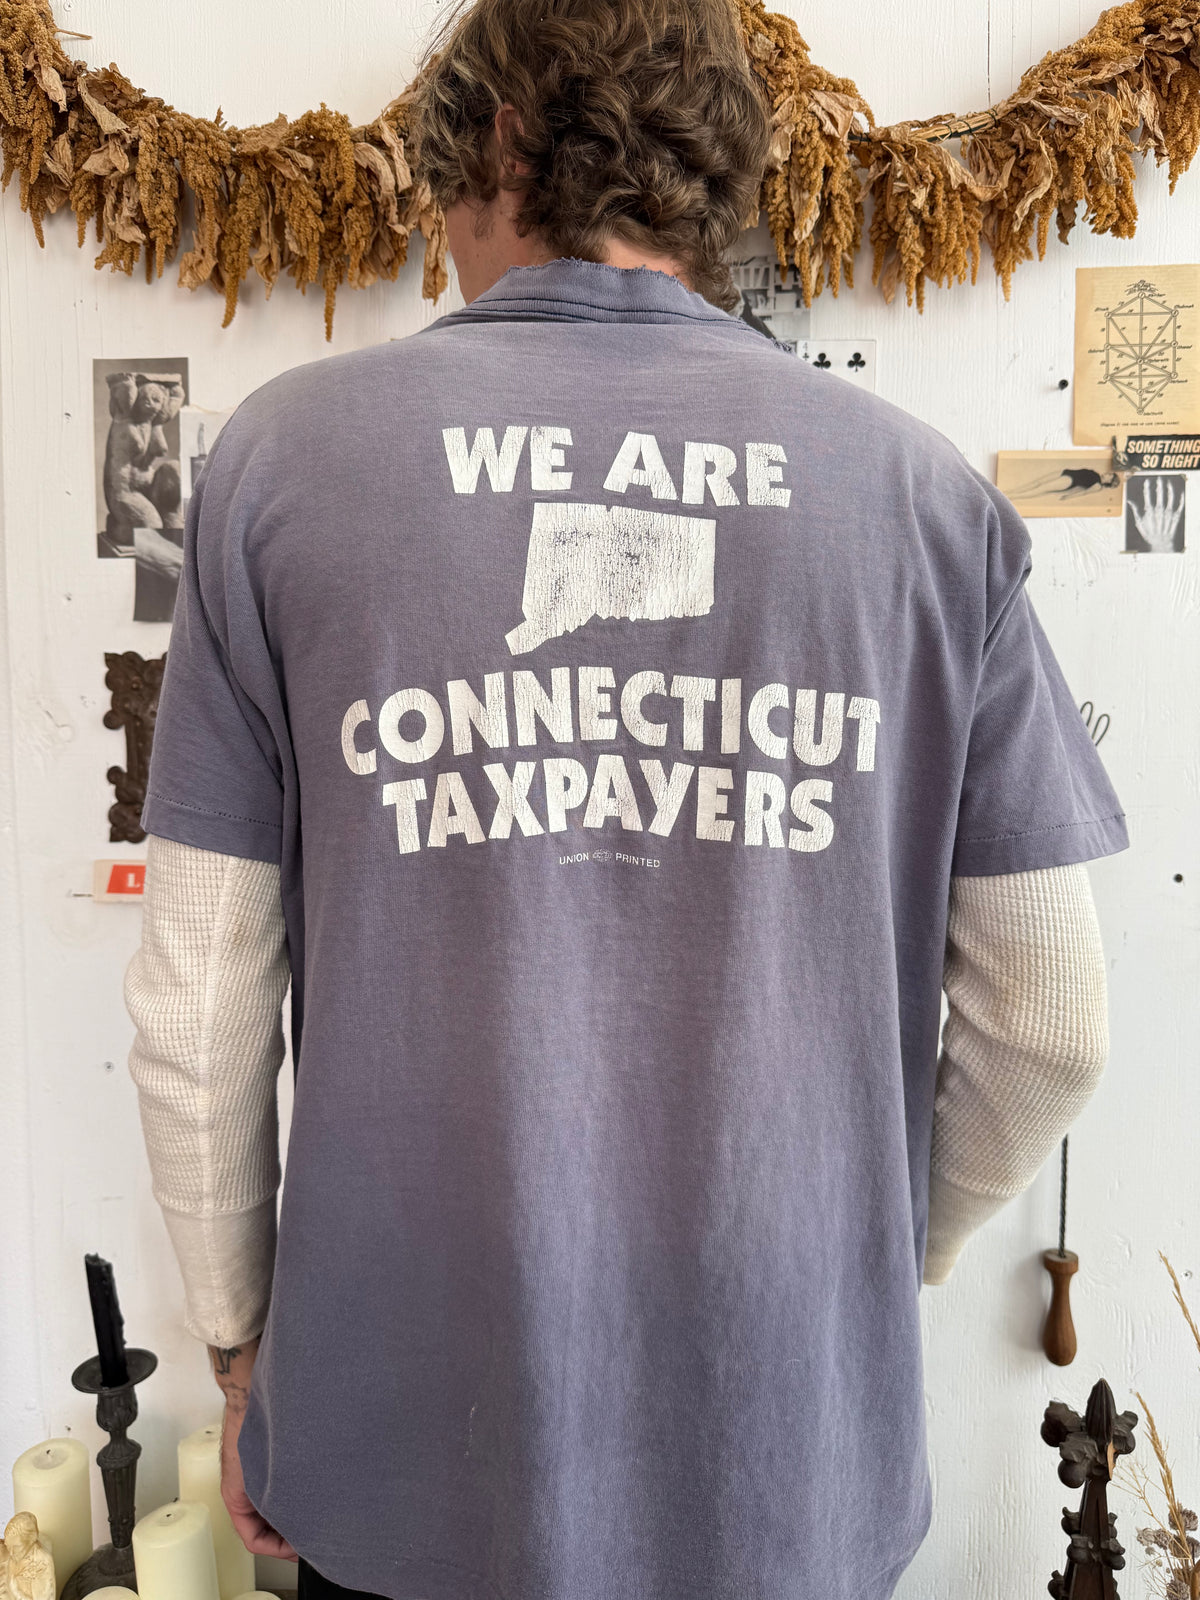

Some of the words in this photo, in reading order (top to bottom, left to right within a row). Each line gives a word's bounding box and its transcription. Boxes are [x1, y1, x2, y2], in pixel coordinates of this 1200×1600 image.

[442, 426, 574, 494] WE
[603, 431, 792, 508] ARE
[1127, 440, 1200, 454] SOMETHING
[1141, 454, 1159, 469] SO
[1161, 454, 1200, 469] RIGHT
[341, 666, 882, 776] CONNECTICUT
[382, 755, 835, 855] TAXPAYERS
[559, 852, 589, 865] UNION
[615, 852, 661, 868] PRINTED
